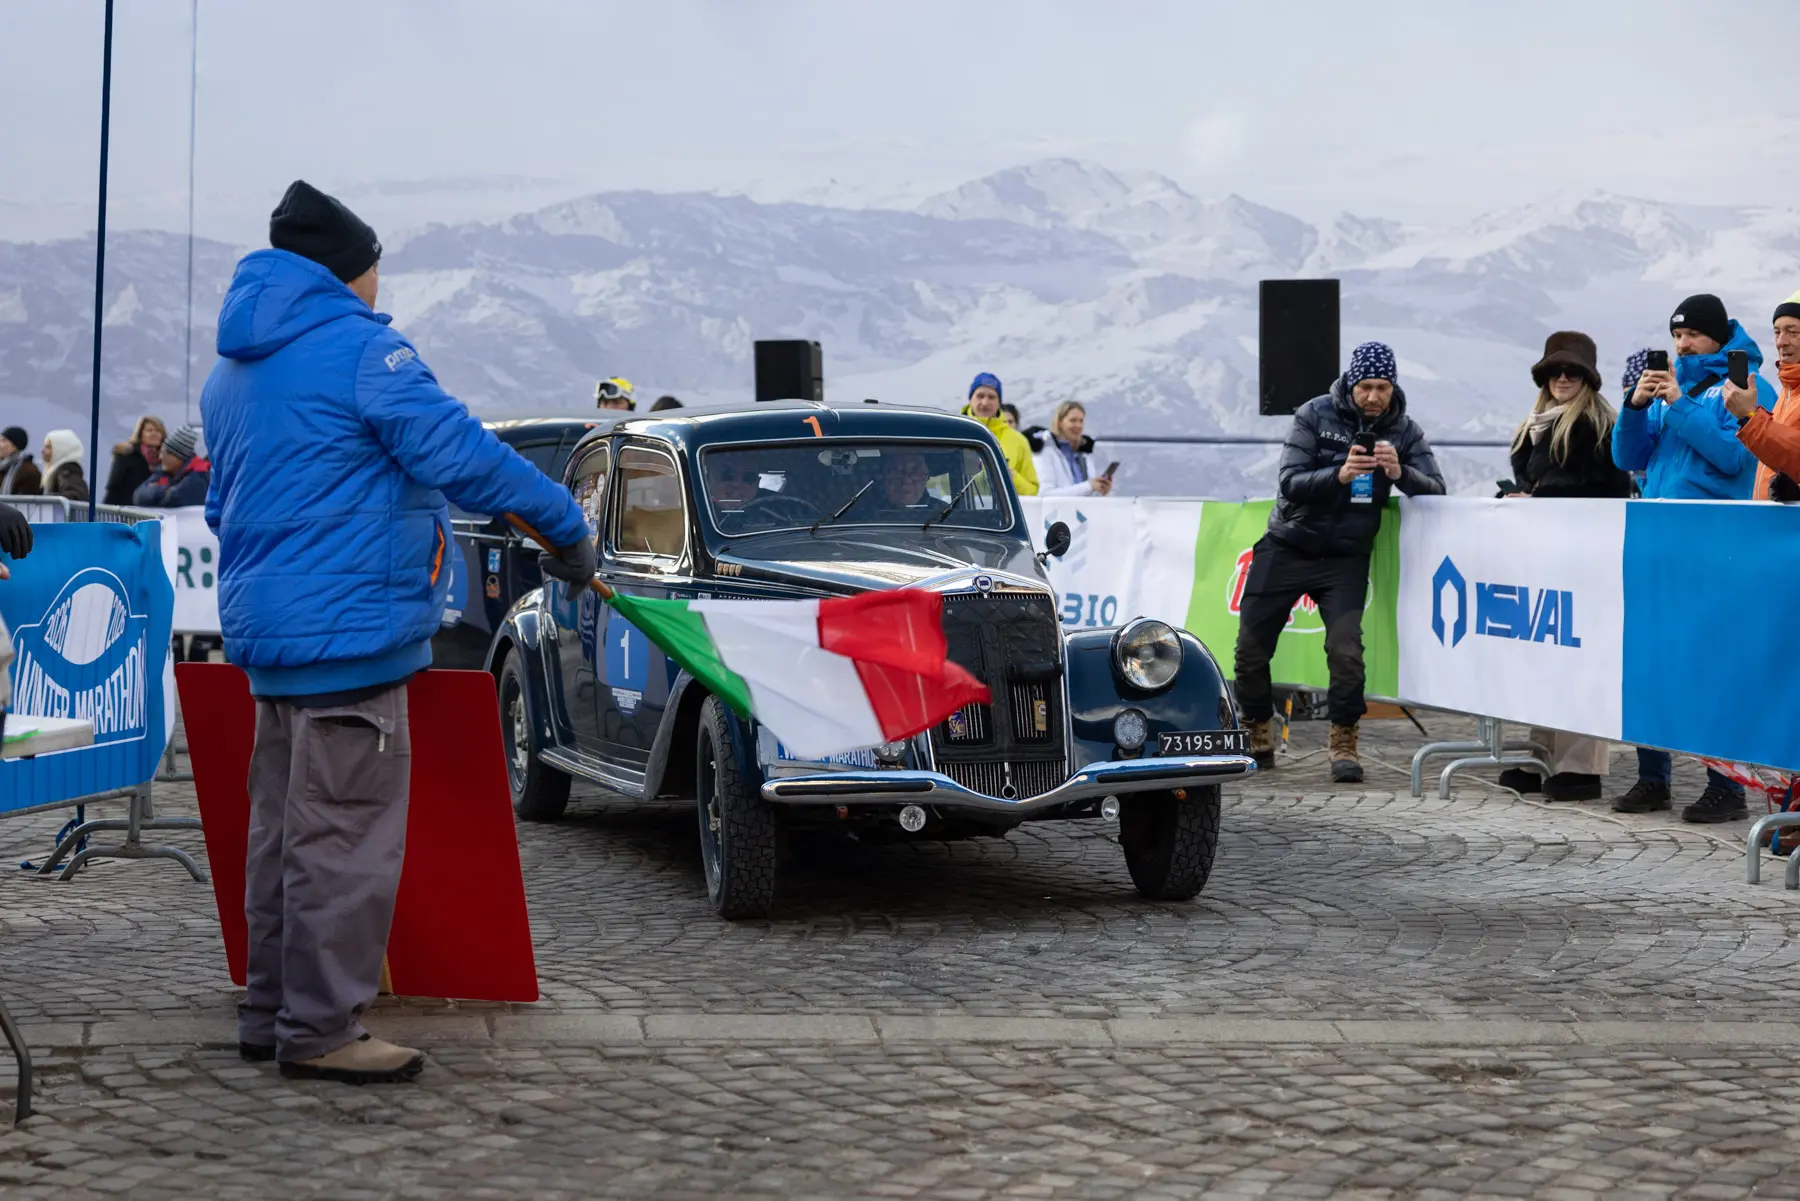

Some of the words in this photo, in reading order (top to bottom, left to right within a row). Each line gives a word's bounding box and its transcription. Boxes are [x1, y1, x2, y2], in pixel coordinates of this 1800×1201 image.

[1475, 581, 1581, 648] ISVAL
[13, 637, 71, 719] WINTER
[74, 627, 147, 735] MARATHON
[620, 629, 630, 680] 1
[1163, 734, 1213, 751] 73195
